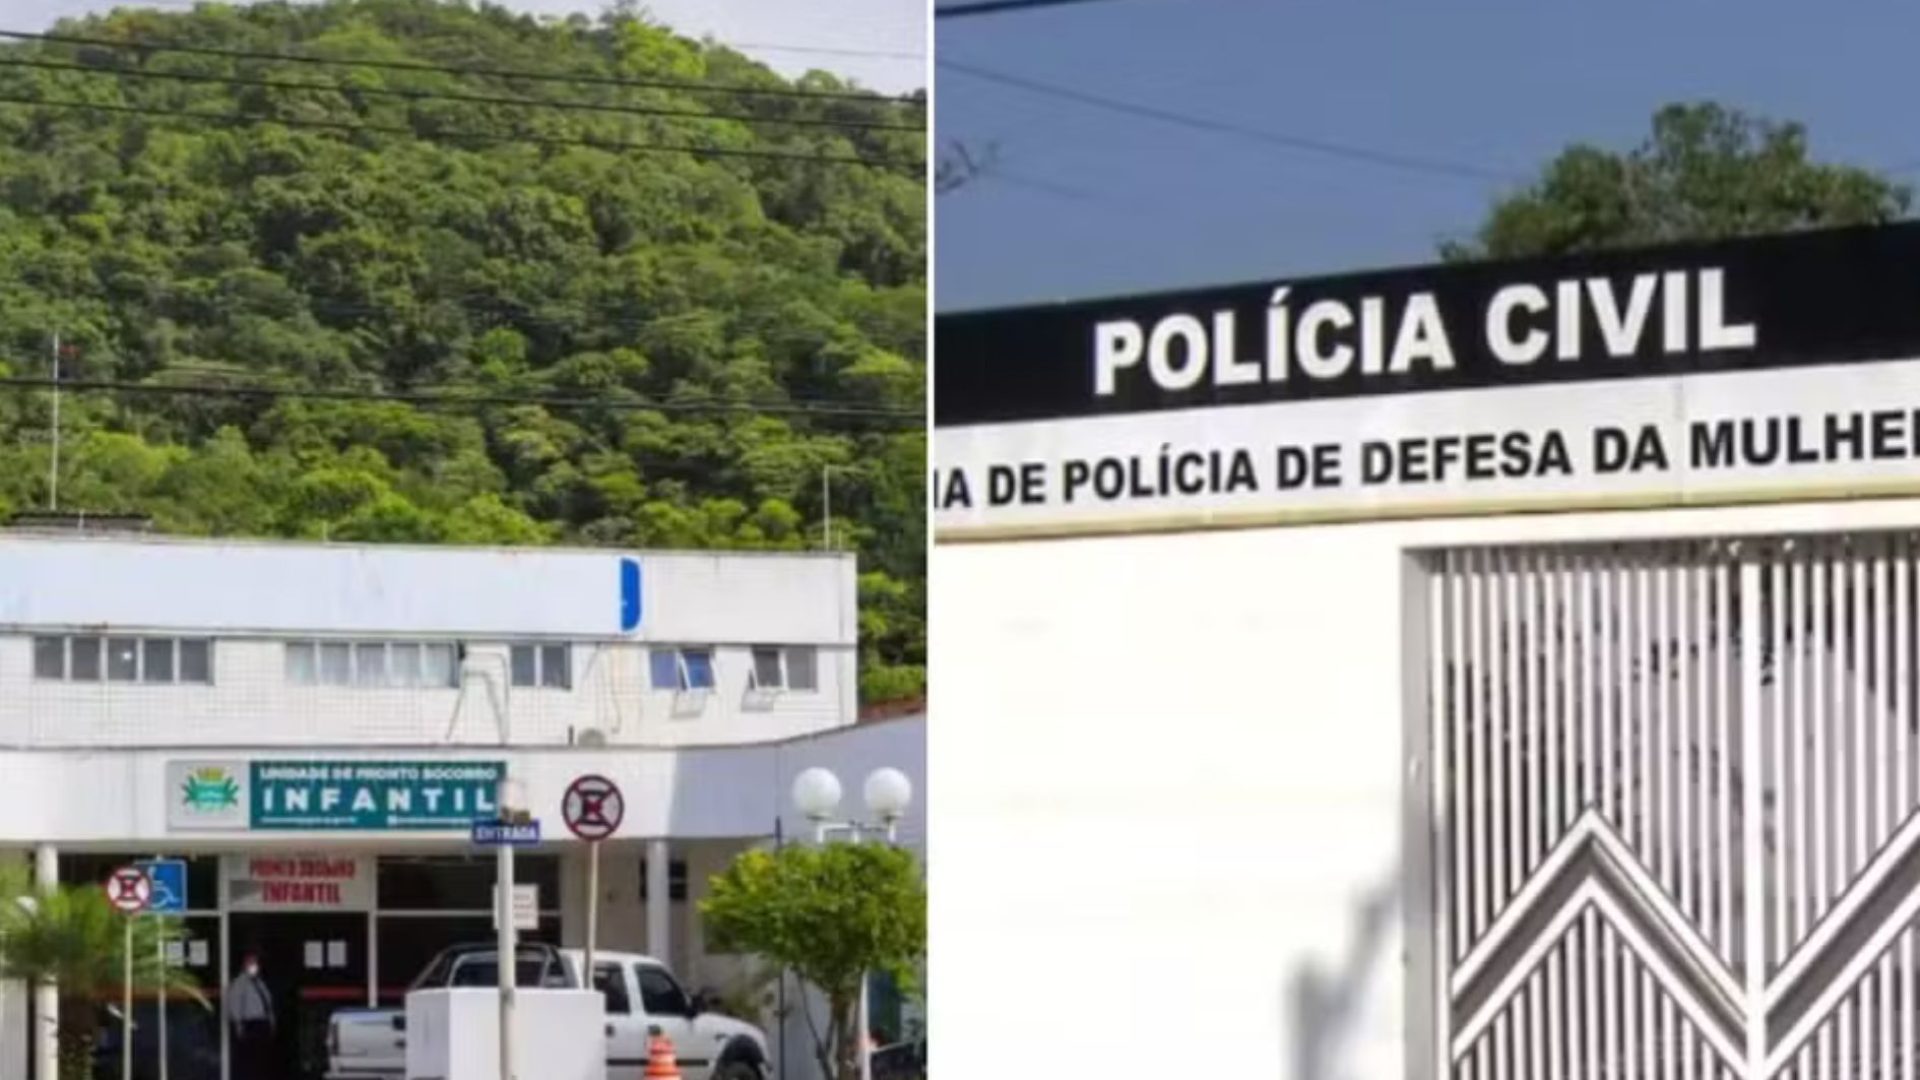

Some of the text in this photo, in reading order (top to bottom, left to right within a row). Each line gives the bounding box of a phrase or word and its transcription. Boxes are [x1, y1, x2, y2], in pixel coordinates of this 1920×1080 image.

[1095, 268, 1756, 395] POLÍCIA CIVIL
[988, 463, 1046, 506] DE
[1063, 443, 1258, 502] POLÍCIA
[1277, 444, 1341, 489] DE
[1361, 430, 1573, 485] DEFESA
[1594, 424, 1668, 473] DA
[1691, 407, 1920, 468] MULHE
[422, 767, 498, 780] SOCORRO
[263, 787, 494, 812] INFANTIL
[263, 881, 341, 903] INFANTIL
